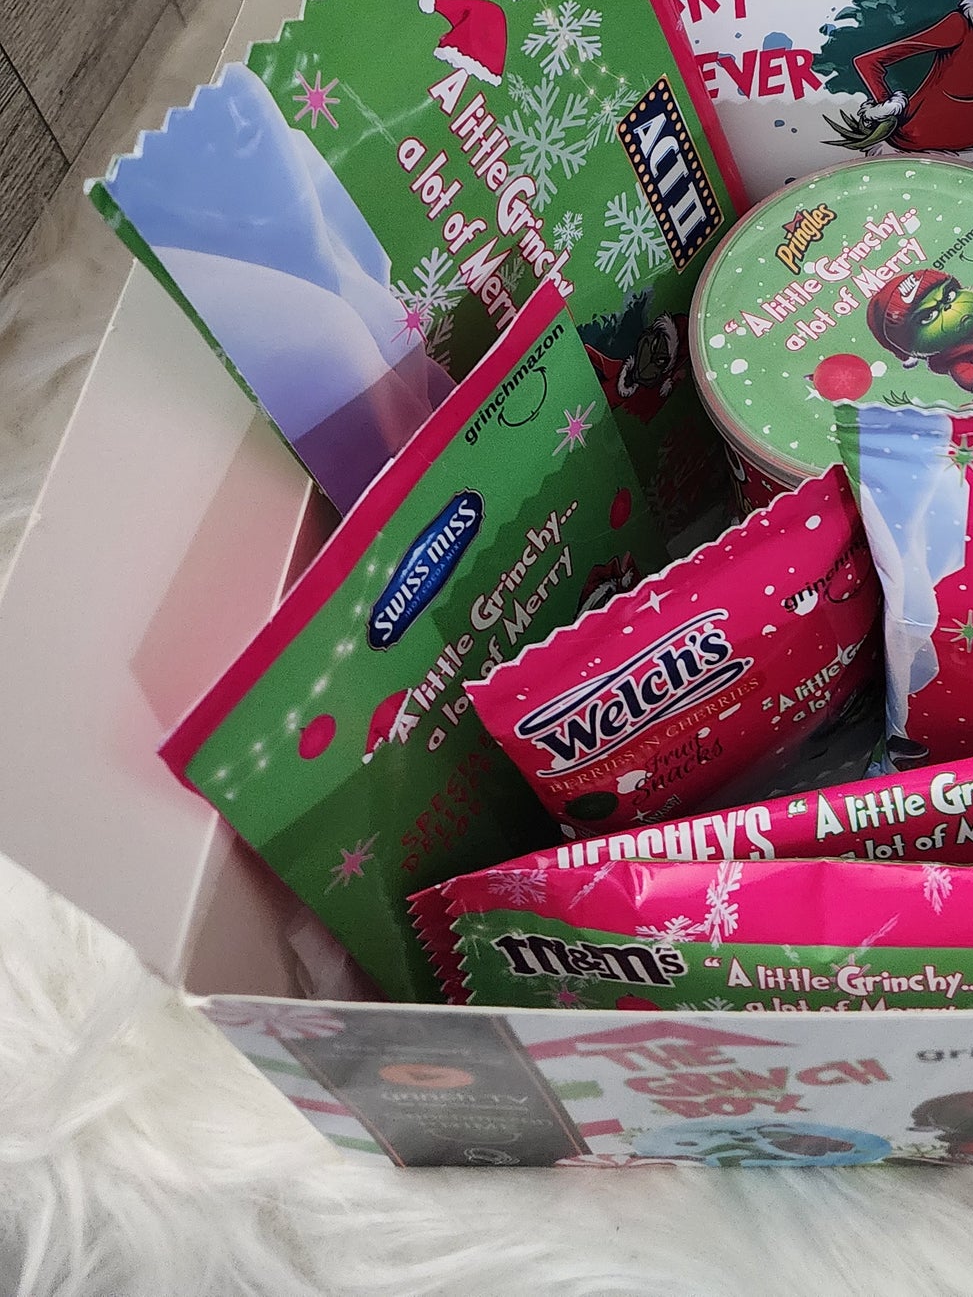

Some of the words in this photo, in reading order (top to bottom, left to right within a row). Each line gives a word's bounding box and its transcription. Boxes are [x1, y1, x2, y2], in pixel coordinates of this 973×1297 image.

[694, 47, 823, 100] EVER
[397, 137, 427, 173] a
[427, 68, 470, 115] A
[450, 91, 512, 190] little
[410, 150, 462, 220] lot
[633, 112, 690, 197] ACT
[668, 181, 707, 246] II
[442, 212, 487, 255] of
[775, 202, 838, 275] Pringles
[459, 236, 518, 330] Merr
[760, 278, 823, 324] little
[784, 331, 807, 352] a
[804, 308, 837, 342] lot
[832, 286, 861, 317] of
[852, 236, 928, 300] Merry
[463, 322, 566, 446] grinchmazon
[374, 558, 430, 641] SWISS
[411, 633, 475, 713] little
[427, 725, 448, 753] a
[440, 695, 470, 726] lo
[480, 634, 504, 678] of
[502, 544, 575, 646] Merry
[795, 663, 841, 701] little
[540, 628, 732, 762] Welch's
[808, 690, 832, 713] lot
[549, 749, 636, 793] BERRIES
[666, 677, 760, 738] CHERRIES
[645, 732, 706, 774] Fruit
[632, 738, 724, 805] Snacks
[845, 785, 926, 833] little
[864, 834, 905, 860] lot
[915, 823, 949, 851] of
[756, 964, 831, 993] little
